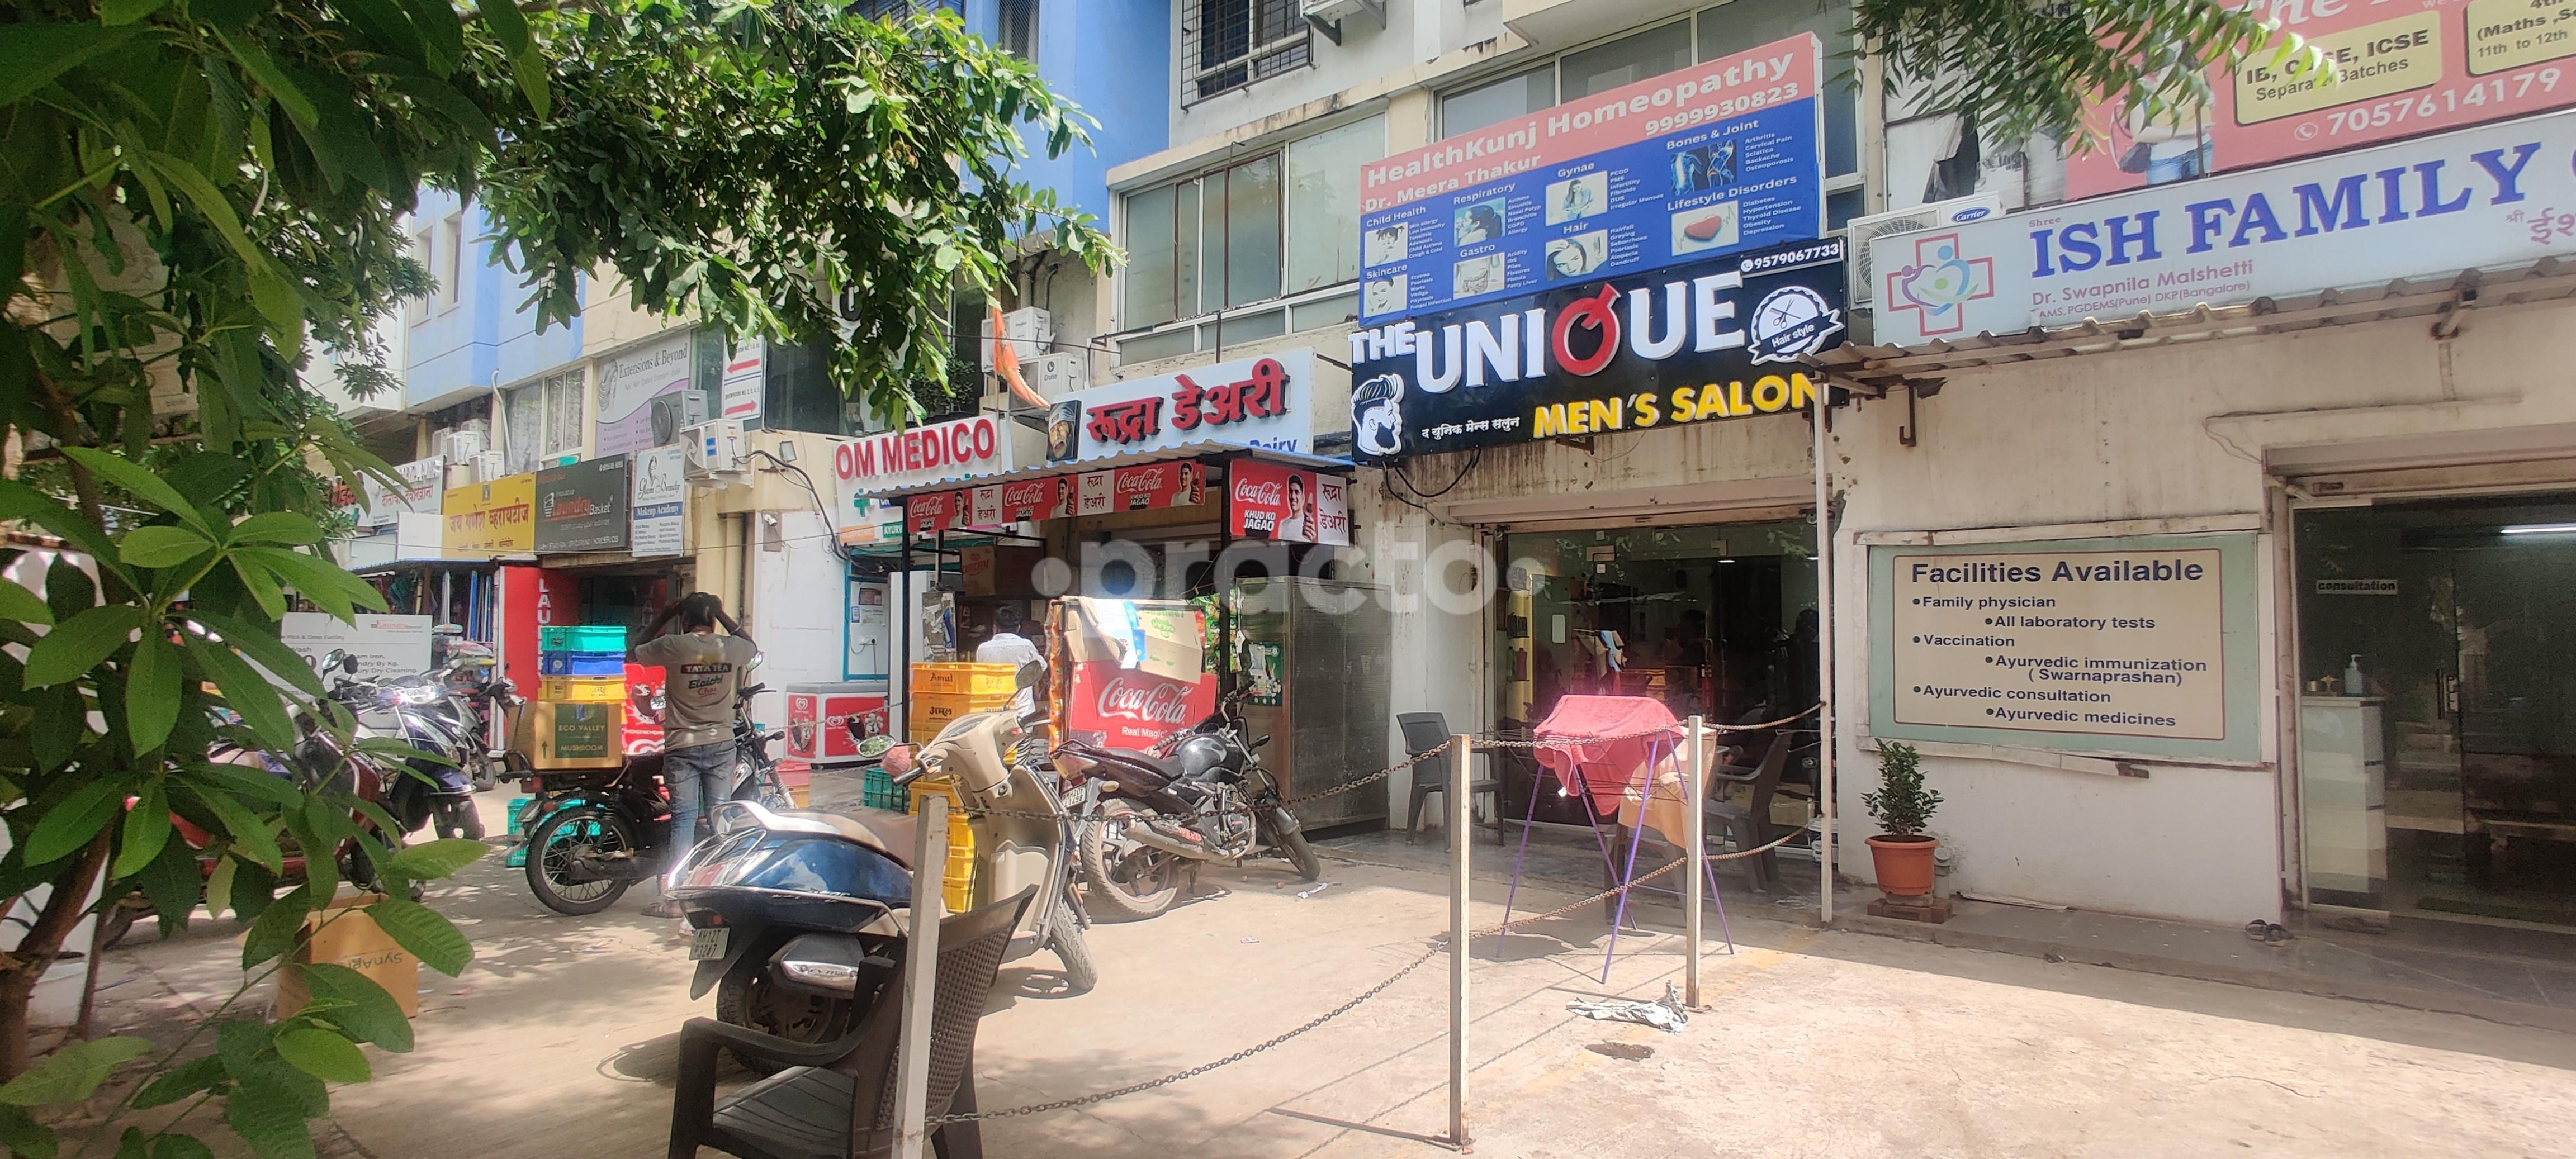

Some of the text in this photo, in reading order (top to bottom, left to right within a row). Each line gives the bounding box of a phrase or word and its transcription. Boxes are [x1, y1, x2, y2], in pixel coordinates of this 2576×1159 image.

[2477, 17, 2546, 41] (Maths
[2367, 29, 2429, 57] ICSE
[2478, 30, 2568, 58] 11th to 12th
[2340, 59, 2409, 83] Batches
[1645, 82, 1798, 136] 9999930823
[2327, 67, 2562, 136] 7057614179
[1367, 53, 1794, 188] HealthKunj Homeopathy
[1666, 120, 1759, 150] Bones & Joint
[1745, 132, 1775, 144] Arthritis
[1745, 135, 1793, 151] Cervical Pain
[1745, 147, 1774, 158] Sciatica
[1745, 153, 1781, 165] Backache
[1557, 162, 1595, 178] Gynae
[1745, 157, 1794, 172] Osteoporosis
[1365, 154, 1542, 212] Dr. Meera Thakur
[1453, 182, 1516, 205] Respiratory
[1667, 175, 1797, 211] Lifestyle Disorders
[1743, 196, 1775, 207] Diabetes
[1366, 206, 1426, 227] Child Health
[1743, 200, 1793, 215] Hypertension
[1743, 205, 1801, 222] Thyroid Disease
[1955, 208, 1988, 222] Carrier
[2029, 141, 2541, 278] ISH FAMILY
[1563, 222, 1589, 235] Hair
[1743, 218, 1772, 229] Obesity
[1743, 223, 1785, 236] Depression
[2028, 217, 2062, 228] Shree
[1460, 244, 1495, 258] Gastro
[1754, 244, 1839, 269] 9579067733
[1366, 264, 1408, 279] Skincare
[2032, 259, 2253, 306] Dr. Swapnila Malshetti
[2068, 280, 2251, 317] PGDEMS(Pune) DKP(Bangalore)
[1348, 269, 1745, 394] THE UNIQUE
[1772, 323, 1815, 348] Hair style
[619, 358, 654, 379] Extensions
[654, 352, 661, 367] &
[661, 342, 688, 366] Beyond
[1044, 372, 1058, 381] Cruise
[1171, 358, 1289, 430] डेअरी
[1671, 372, 1829, 422] SALON
[1421, 428, 1429, 438] द
[1431, 423, 1463, 440] युनिक
[835, 417, 996, 481] OM MEDICO
[1117, 467, 1165, 494] Coca-Cola
[1005, 482, 1046, 507] Coca-Cola
[1235, 478, 1282, 506] Coca-Cola
[910, 496, 943, 518] Coca-Cola
[1244, 510, 1276, 520] KHUD KO
[1244, 518, 1275, 531] JAGAO
[1912, 559, 2204, 583] Facilities Available
[2318, 581, 2395, 591] consultation
[1922, 596, 2056, 610] Family physician
[1994, 616, 2156, 630] All laboratory tests
[1924, 634, 2015, 647] Vaccination
[1995, 655, 2208, 672] Ayurvedic immunization
[930, 672, 953, 682] Amul
[2038, 668, 2183, 687] Swarnaprashan)
[1097, 677, 1194, 725] Coca-Cola
[1923, 685, 2111, 704] Ayurvedic consultation
[1995, 707, 2176, 727] Ayurvedic medicines
[1121, 726, 1165, 739] Real Magic
